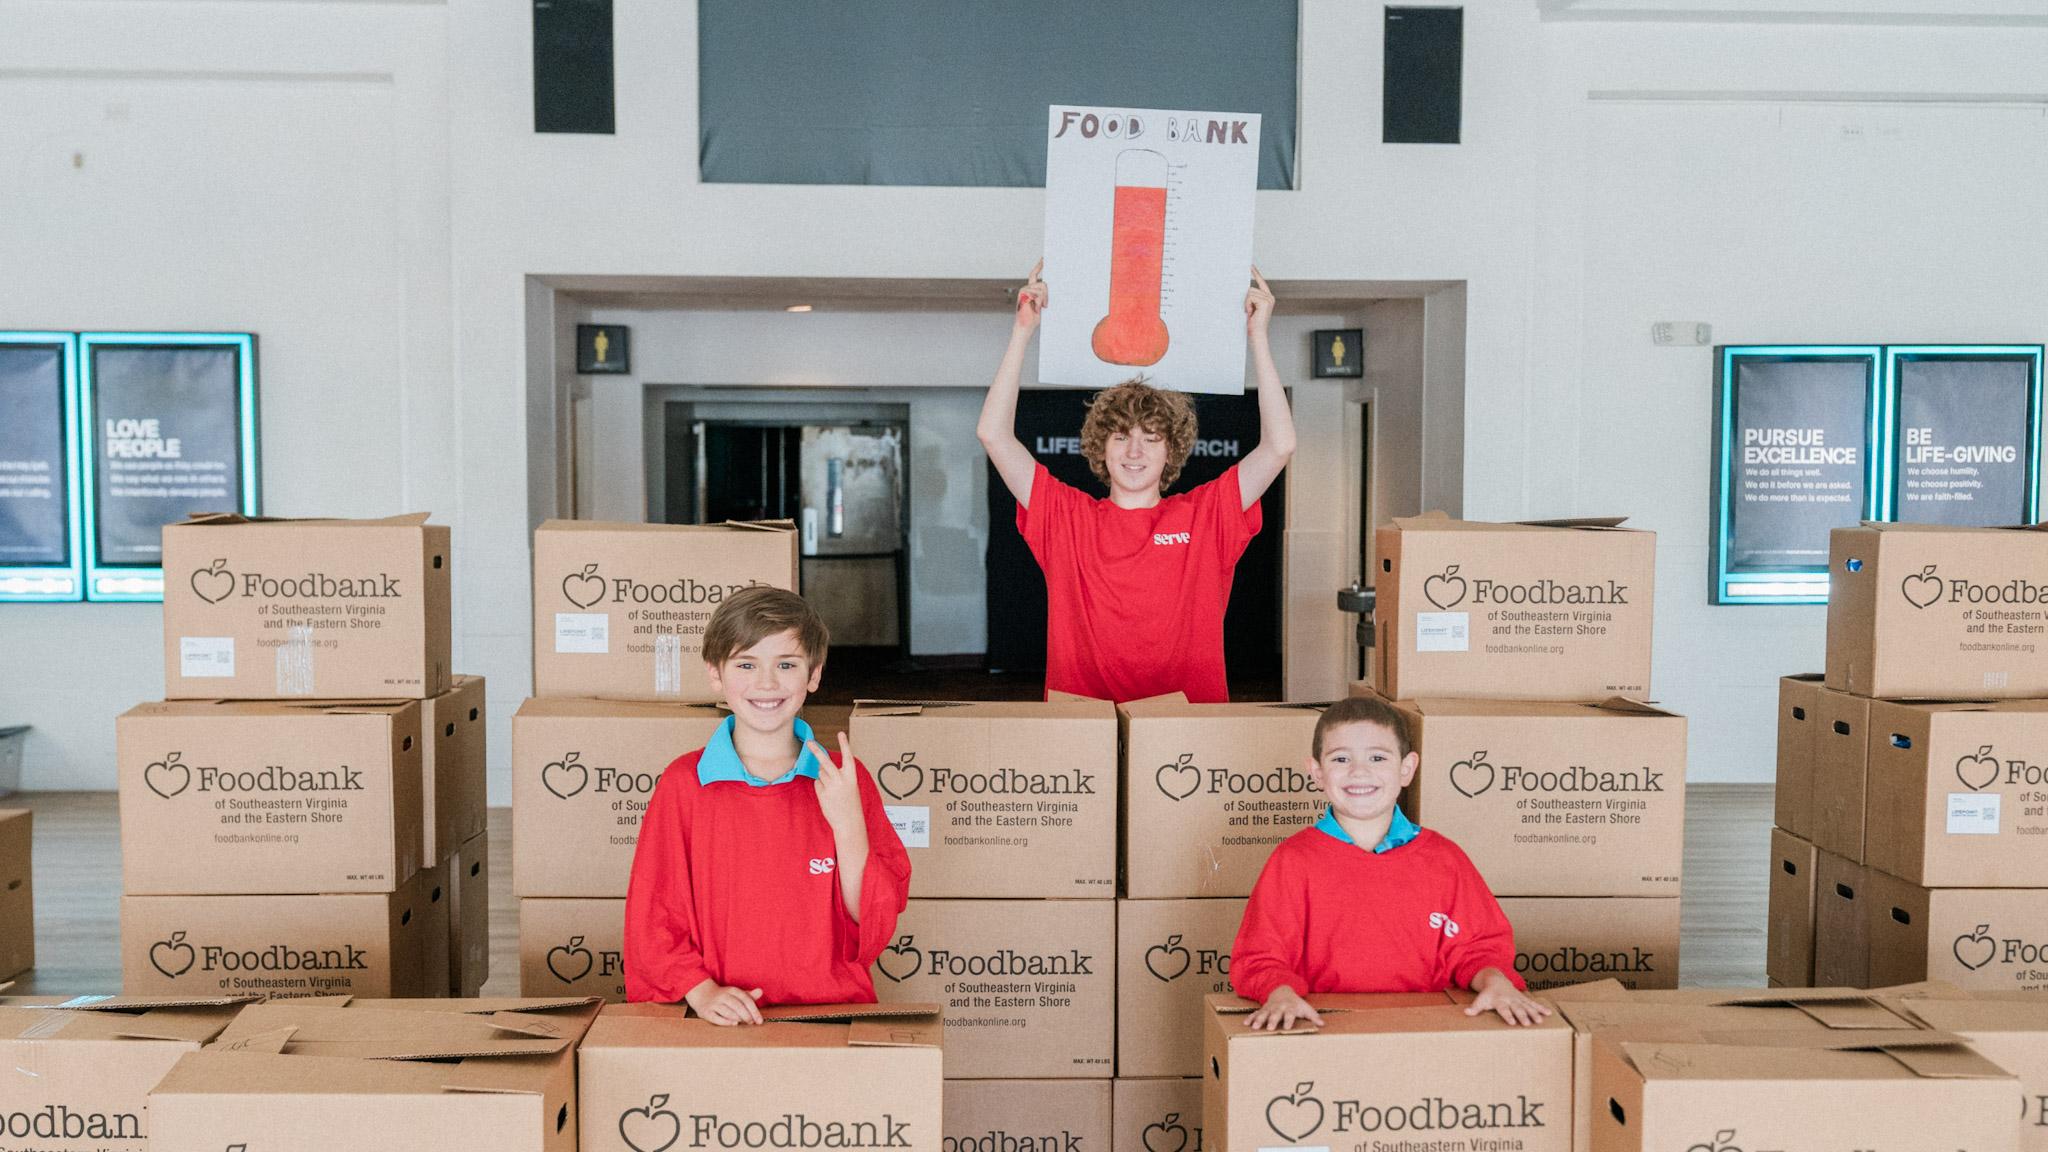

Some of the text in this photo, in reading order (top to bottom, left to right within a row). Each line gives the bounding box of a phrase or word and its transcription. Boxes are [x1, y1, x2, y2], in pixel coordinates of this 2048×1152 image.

[1054, 111, 1248, 145] FOOD BANK
[106, 419, 160, 438] LOVE
[1745, 429, 1824, 446] PURSUE
[1907, 428, 1932, 445] BE
[107, 438, 181, 458] PEOPLE
[1194, 440, 1239, 457] RCH
[1745, 447, 1856, 465] EXCELLENCE
[1907, 446, 2016, 463] LIFE-GIVING
[1745, 468, 1821, 478] We do all things well.
[1154, 531, 1190, 545] serve
[241, 573, 401, 598] Foodbank
[1472, 580, 1628, 604] Foodbank
[258, 604, 386, 617] of Southeastern Virginia
[628, 609, 711, 620] of Southeastern
[1487, 610, 1612, 622] of Southeastern Virginia
[1963, 610, 1972, 620] of
[1976, 609, 2041, 620] Southeastern
[263, 618, 283, 629] and
[307, 618, 347, 629] Eastern
[350, 618, 381, 629] Shore
[633, 624, 653, 634] and
[656, 624, 673, 634] the
[1967, 624, 2044, 633] and the Eastern
[1492, 625, 1606, 635] and the Eastern Shore
[1485, 644, 1564, 655] foodbankonline.org
[1960, 642, 2035, 653] foodbankonline.org
[197, 766, 364, 791] Foodbank
[930, 768, 1095, 794] Foodbank
[1501, 767, 1664, 792] Foodbank
[2020, 791, 2031, 802] of
[215, 798, 347, 810] of Southeastern Virginia
[612, 800, 622, 811] of
[946, 801, 1078, 814] of Southeastern Virginia
[1224, 800, 1234, 811] of
[1238, 800, 1309, 811] Southeastern
[1516, 799, 1646, 811] of Southeastern Virginia
[2024, 806, 2043, 816] and
[221, 812, 343, 824] and the Eastern Shore
[617, 815, 637, 825] and
[951, 815, 1073, 827] and the Eastern Shore
[1229, 814, 1314, 825] and the Eastern
[1521, 813, 1641, 824] and the Eastern Shore
[214, 833, 299, 844] foodbankonline.org
[944, 836, 1028, 847] foodbankonline.org
[1513, 834, 1596, 845] foodbankonline.org
[201, 945, 368, 971] Foodbank
[928, 950, 1093, 976] Foodbank
[2016, 970, 2027, 981] of
[219, 976, 352, 989] of Southeastern Virginia
[945, 982, 1076, 995] of Southeastern Virginia
[950, 996, 1071, 1008] and the Eastern Shore
[943, 1017, 1026, 1028] foodbankonline.org
[1332, 1095, 1545, 1132] Foodbank
[689, 1114, 912, 1148] Foodbank
[1354, 1137, 1523, 1152] of Southeastern Virginia
